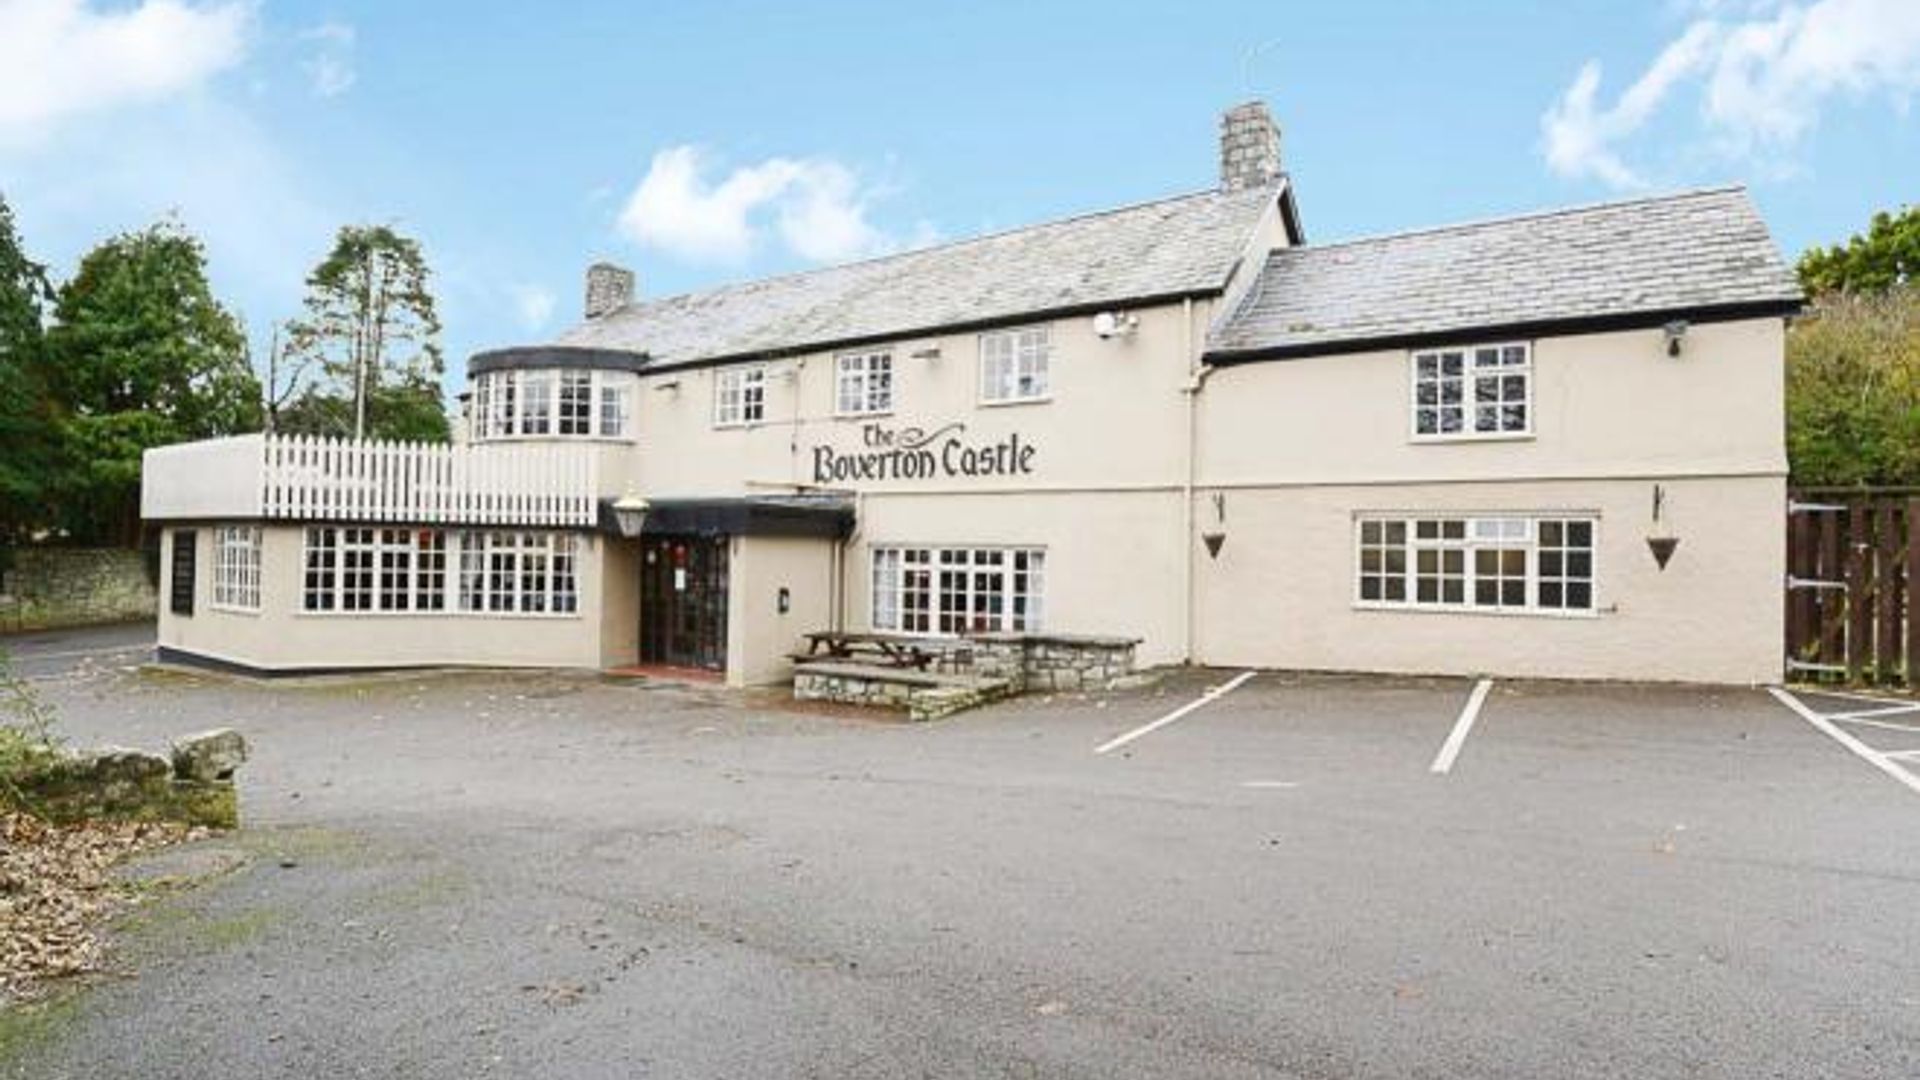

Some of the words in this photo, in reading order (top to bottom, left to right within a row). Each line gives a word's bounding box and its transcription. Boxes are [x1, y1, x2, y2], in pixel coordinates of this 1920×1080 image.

[863, 423, 895, 447] The
[813, 445, 936, 483] Boverton
[942, 433, 1036, 477] Castle
